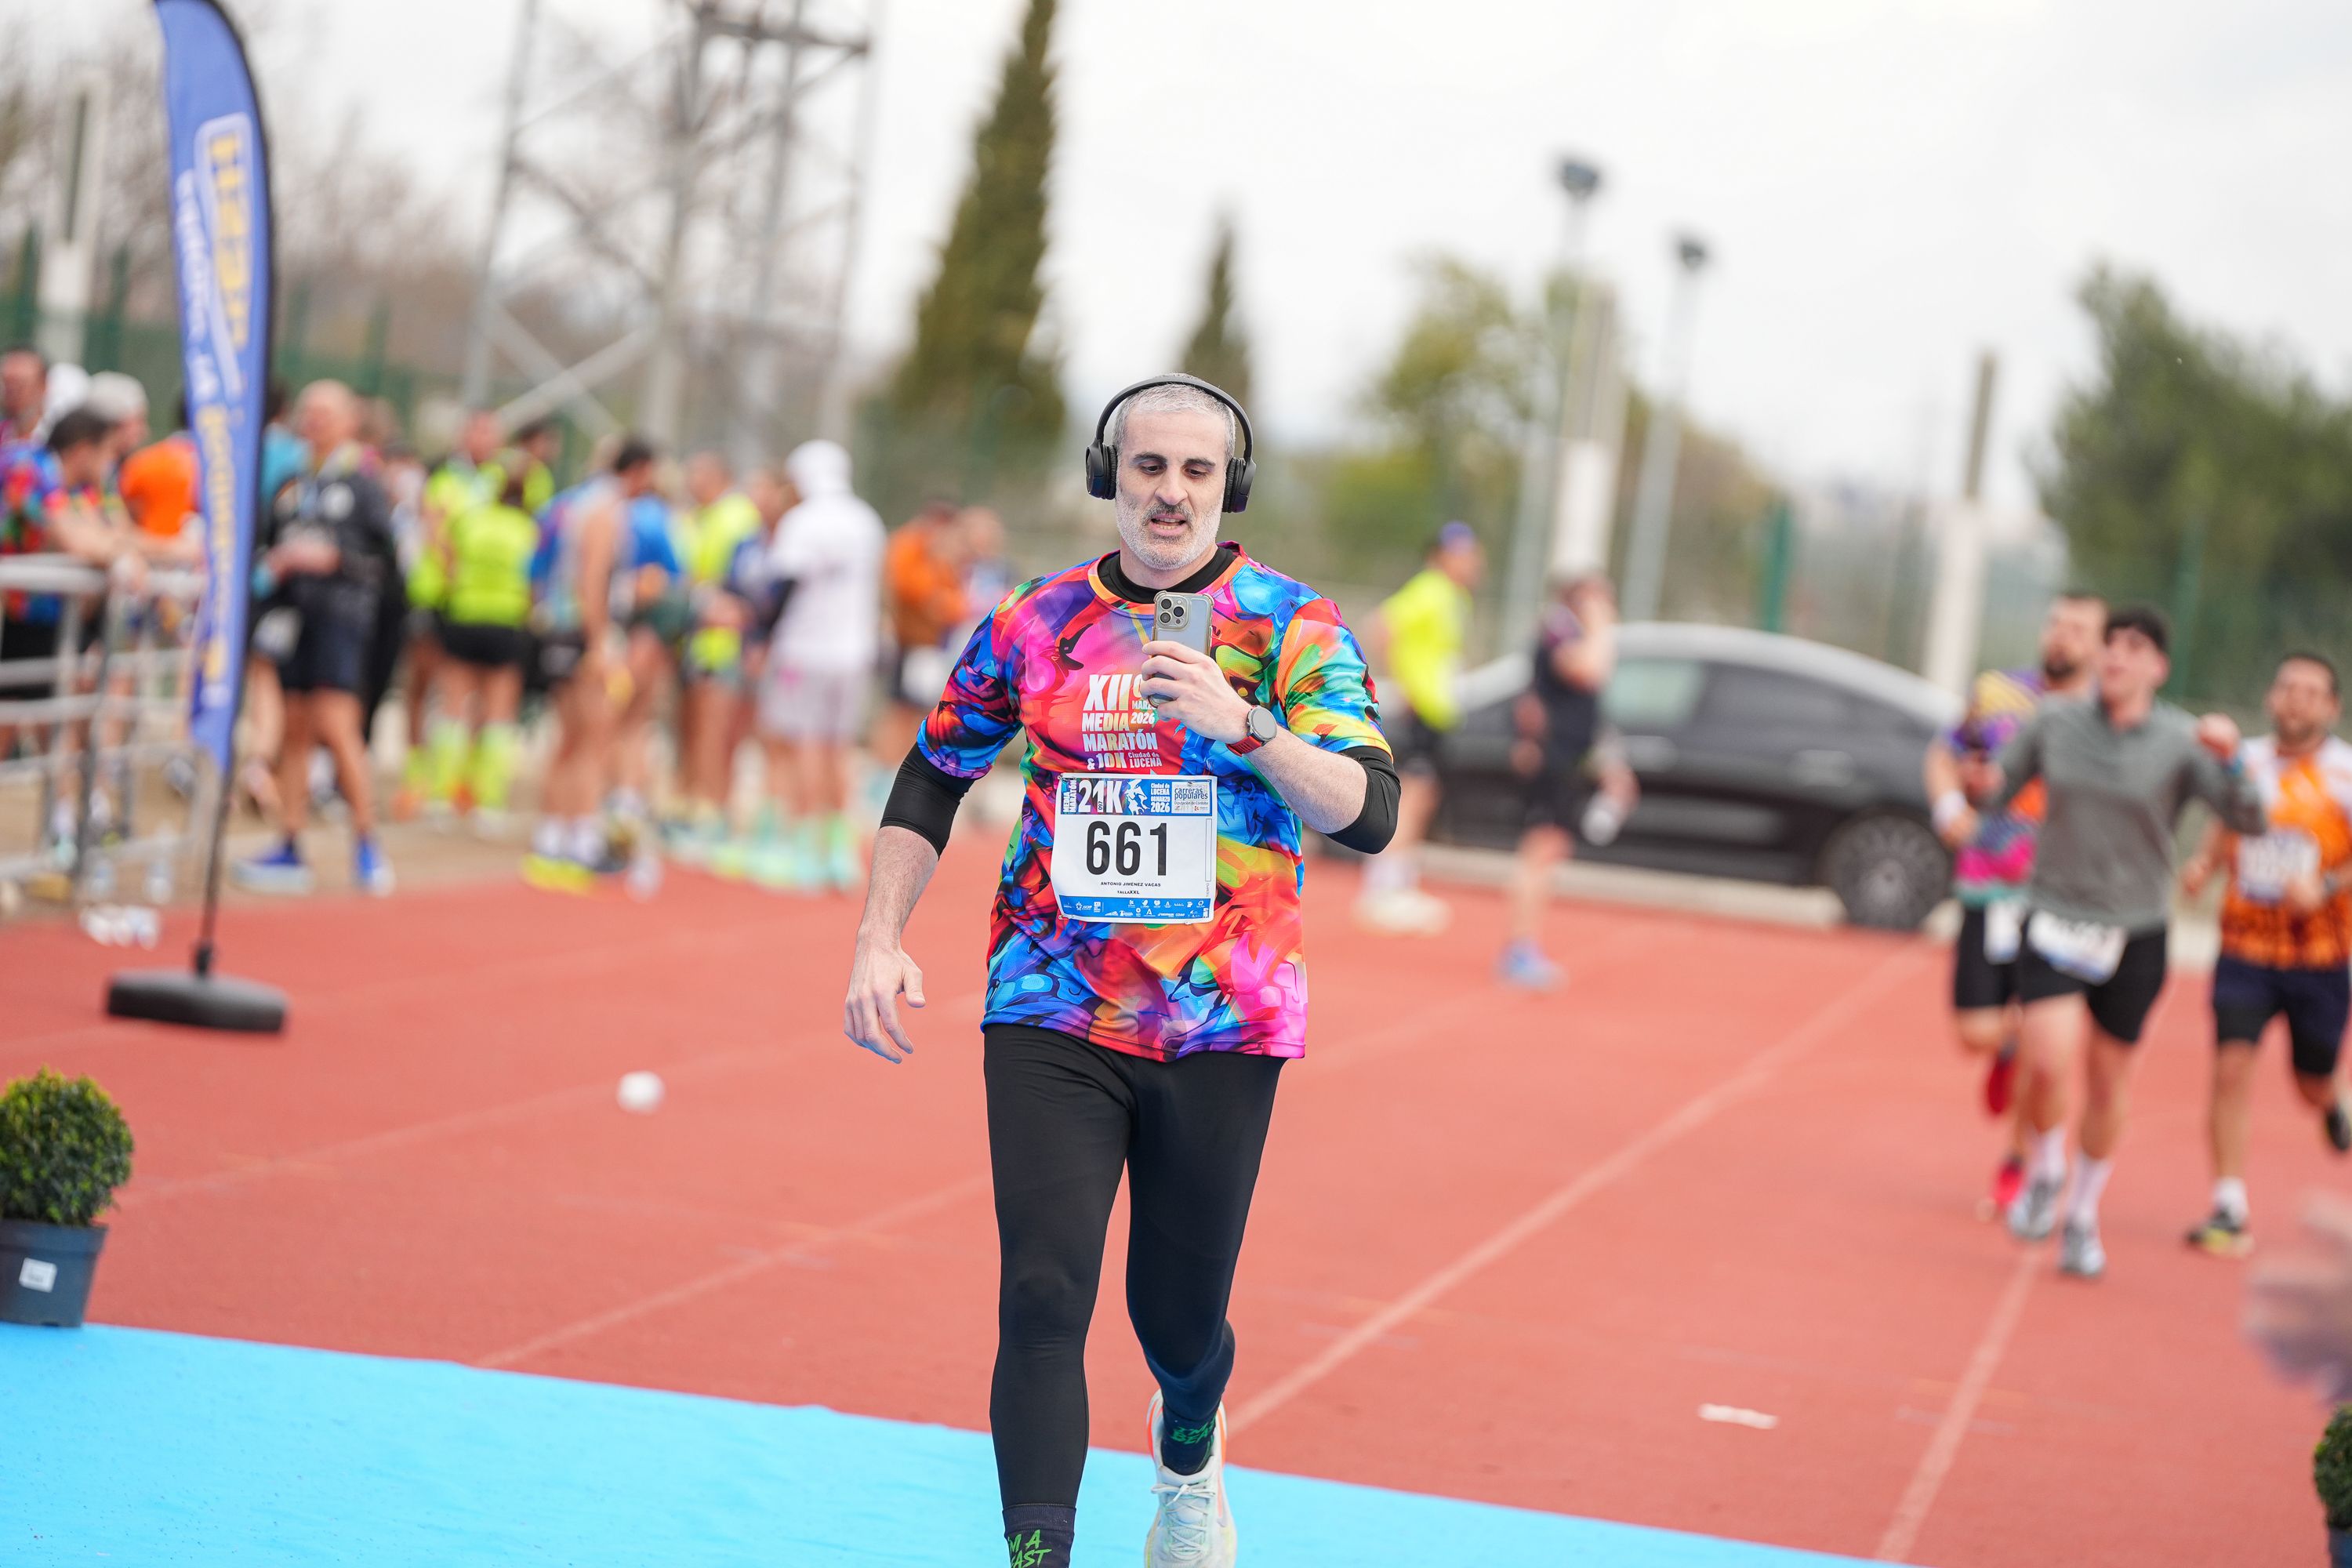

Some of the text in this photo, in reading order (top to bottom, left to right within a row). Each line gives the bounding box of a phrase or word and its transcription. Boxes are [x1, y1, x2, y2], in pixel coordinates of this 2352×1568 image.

[1083, 674, 1133, 710] XII
[1082, 713, 1130, 731] MEDIA
[1131, 712, 1155, 724] 2026
[1082, 729, 1158, 752] MARATÓN
[1087, 753, 1127, 771] & 10K
[1129, 757, 1163, 768] LUCENA
[1078, 779, 1123, 813] 21K
[1150, 802, 1171, 813] 2026
[1087, 821, 1167, 876] 661
[1025, 1530, 1043, 1550] A
